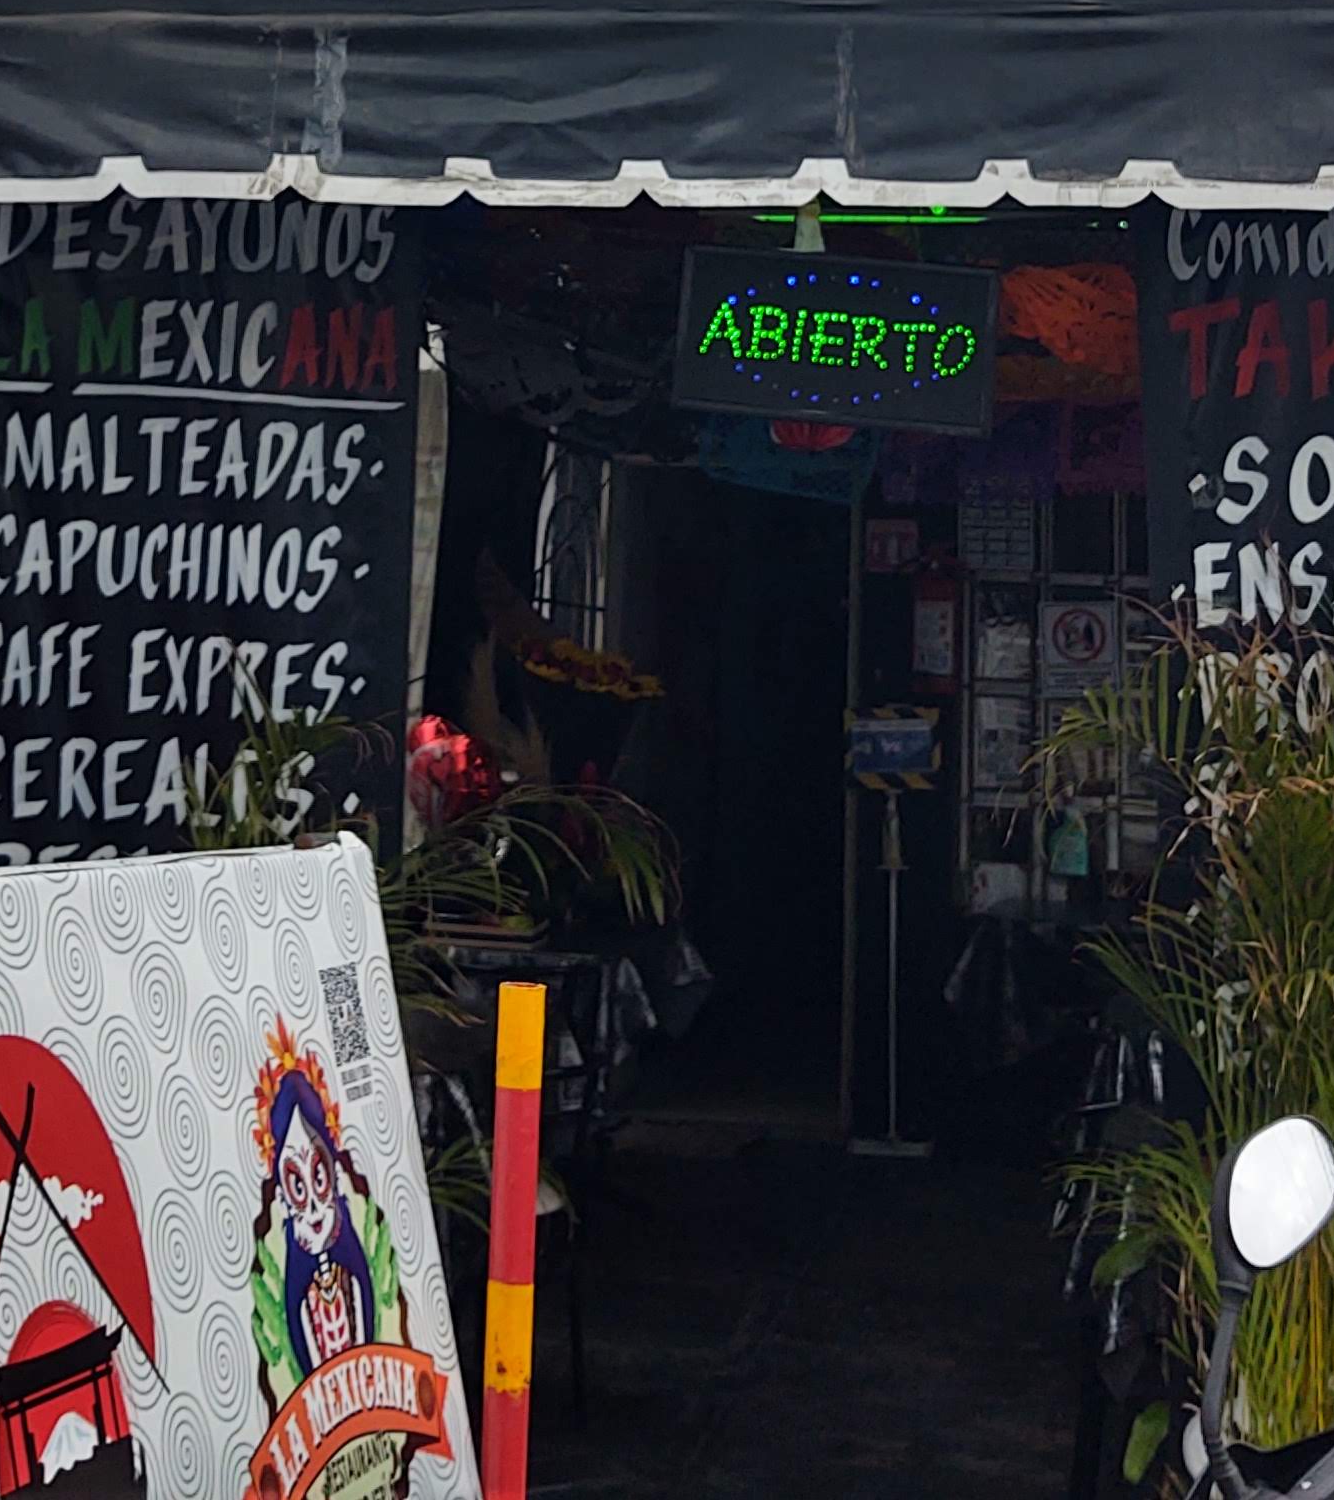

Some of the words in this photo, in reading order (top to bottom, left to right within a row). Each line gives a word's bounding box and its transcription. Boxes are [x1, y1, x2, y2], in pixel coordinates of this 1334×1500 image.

[77, 295, 398, 391] MEXICANA
[698, 301, 976, 378] ABIERTO
[4, 411, 369, 505] MALTEADAS
[127, 628, 351, 727] EXPRES
[269, 1412, 311, 1499] LA
[302, 1354, 420, 1447] MEXICANA
